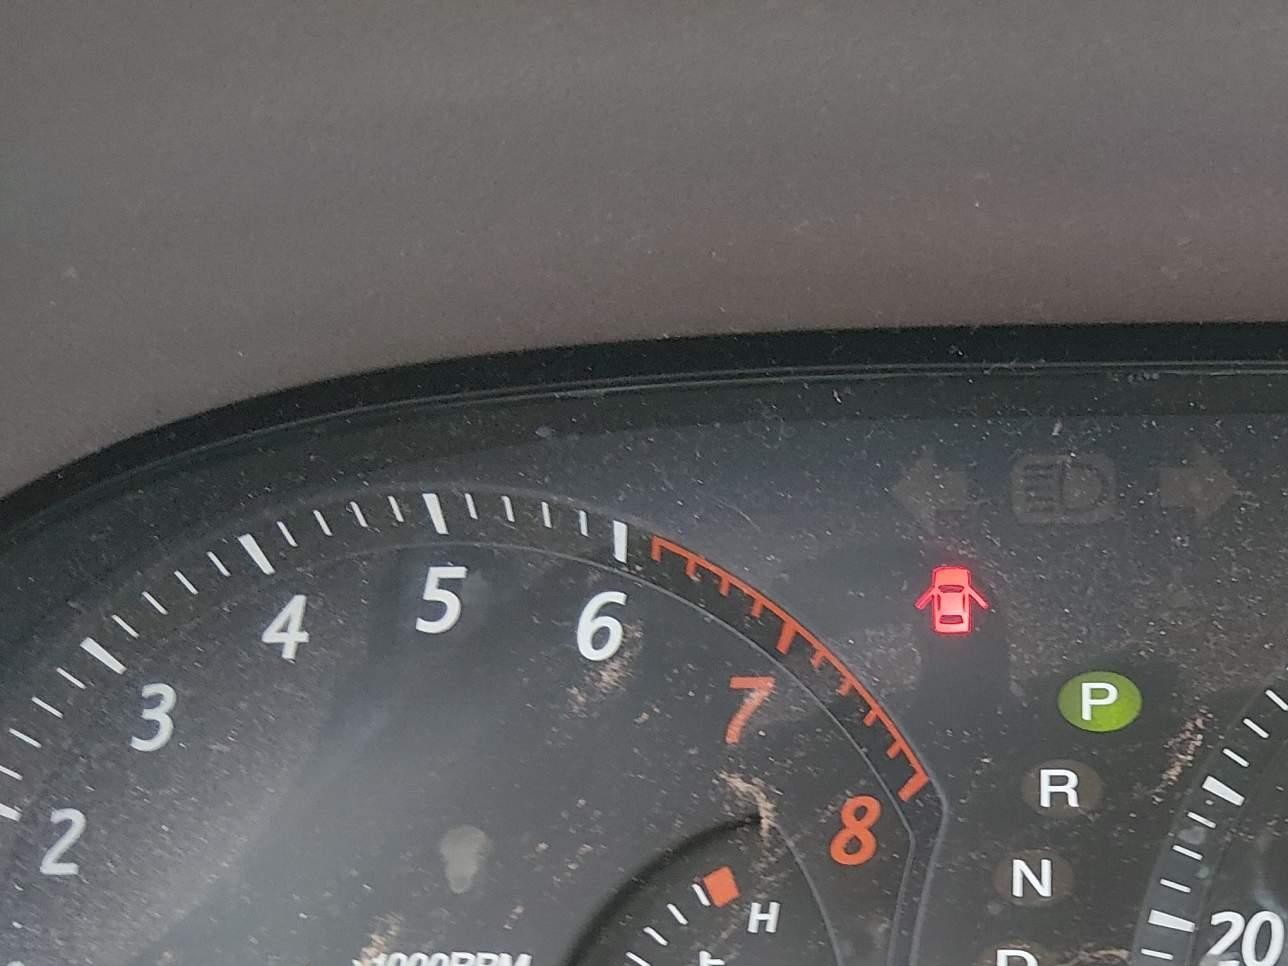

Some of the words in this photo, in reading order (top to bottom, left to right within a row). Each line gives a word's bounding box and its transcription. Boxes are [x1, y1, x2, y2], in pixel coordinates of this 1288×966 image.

[261, 594, 309, 660] 4
[416, 566, 468, 633] 5
[576, 591, 627, 661] 6
[130, 683, 177, 751] 3
[725, 677, 776, 744] 7
[1081, 682, 1118, 721] P
[1040, 769, 1079, 807] R
[40, 809, 86, 875] 2
[830, 795, 881, 865] 8
[1012, 859, 1051, 897] N
[747, 902, 780, 933] H
